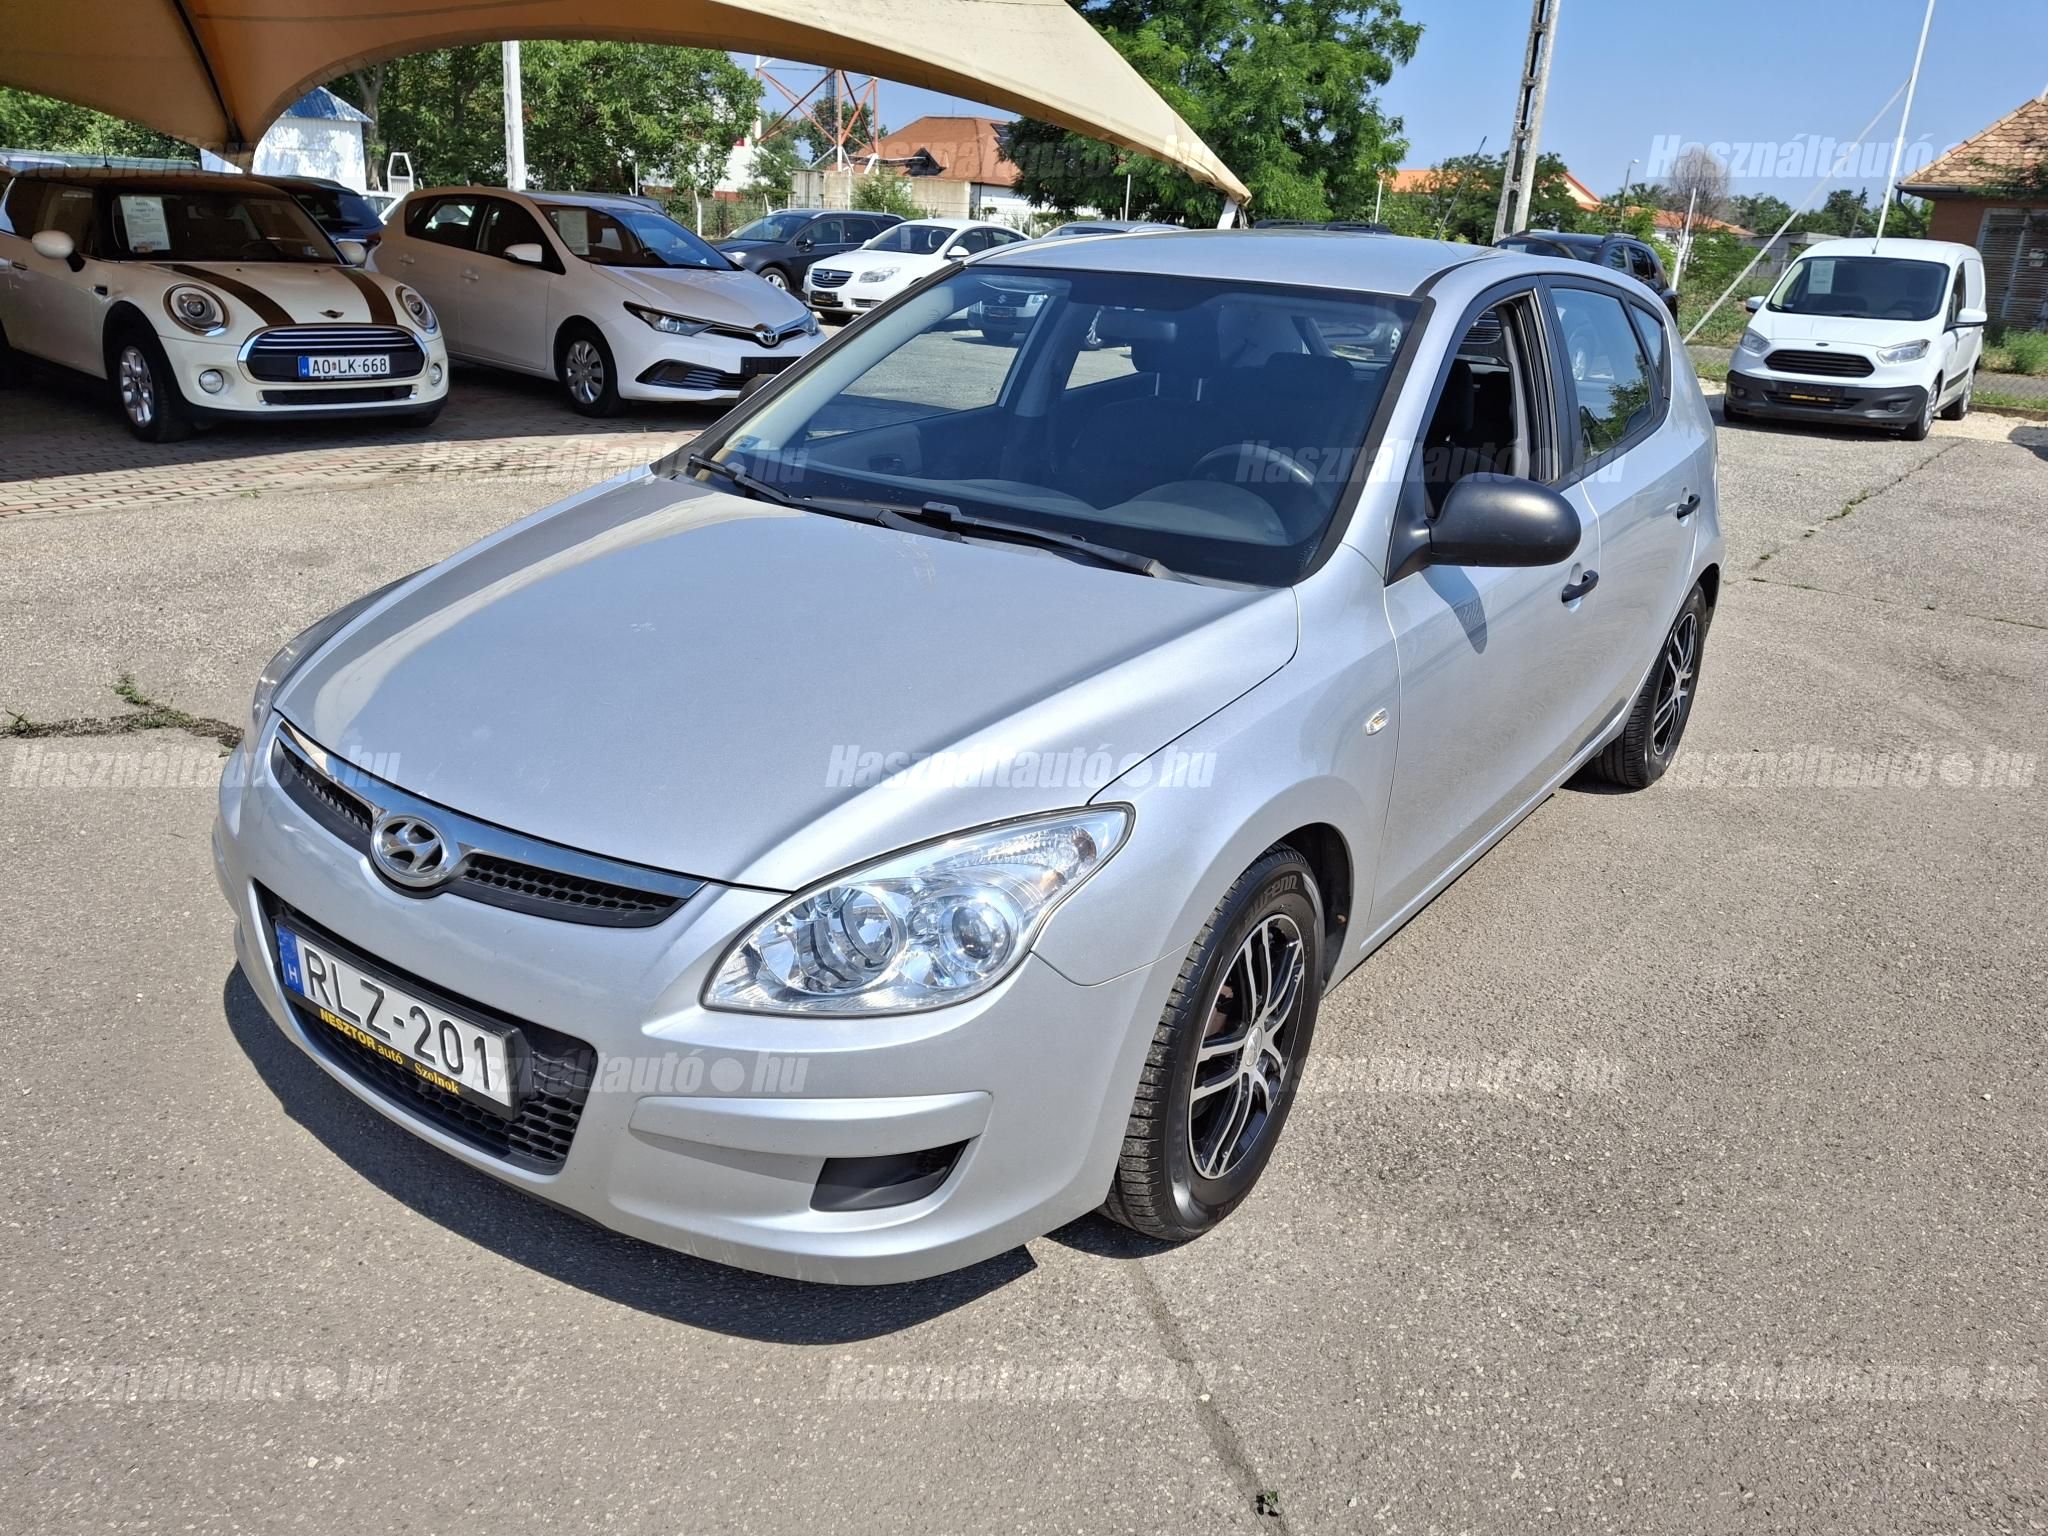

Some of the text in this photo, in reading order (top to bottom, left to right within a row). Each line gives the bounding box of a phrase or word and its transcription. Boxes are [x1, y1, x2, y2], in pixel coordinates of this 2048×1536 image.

[304, 945, 492, 1091] RLZ-201
[320, 1008, 459, 1095] NESZTOR autó Szolnok
